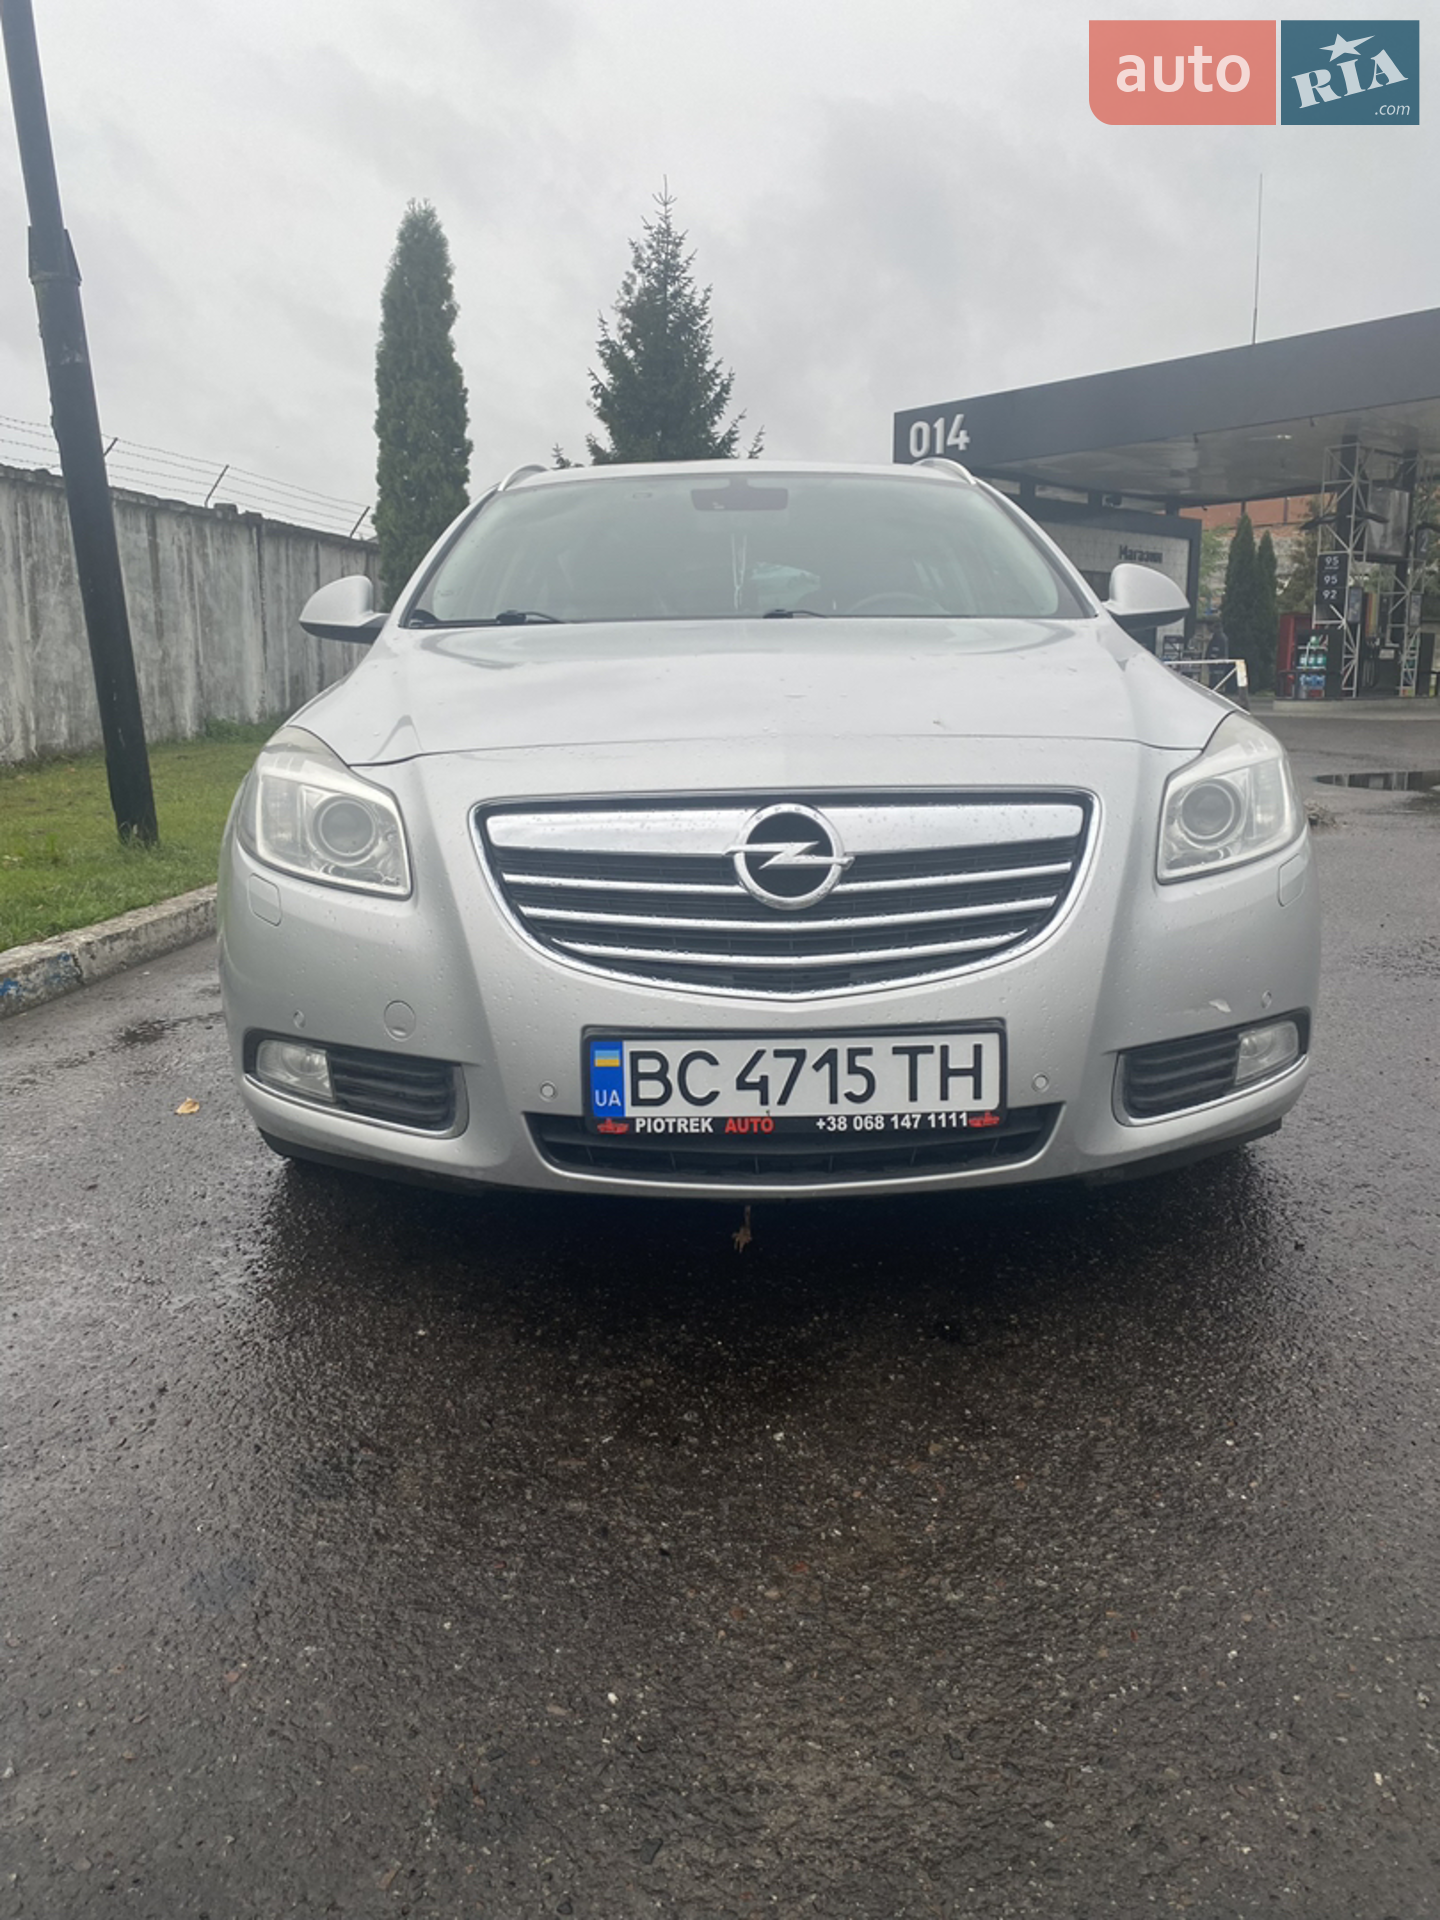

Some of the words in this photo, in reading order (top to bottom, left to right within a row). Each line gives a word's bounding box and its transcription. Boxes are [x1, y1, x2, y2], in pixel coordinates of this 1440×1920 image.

[909, 413, 971, 458] 014
[1325, 555, 1340, 566] 95
[1323, 575, 1338, 585] 95
[1322, 589, 1338, 600] 92
[629, 1050, 721, 1107] BC
[736, 1047, 876, 1106] 4715
[892, 1043, 983, 1102] TH
[594, 1089, 622, 1107] UA
[635, 1117, 714, 1134] PIOTREK
[724, 1116, 775, 1134] AUTO
[815, 1115, 848, 1132] +38
[852, 1114, 885, 1131] 068
[890, 1113, 922, 1130] 147
[927, 1111, 968, 1129] 1111
